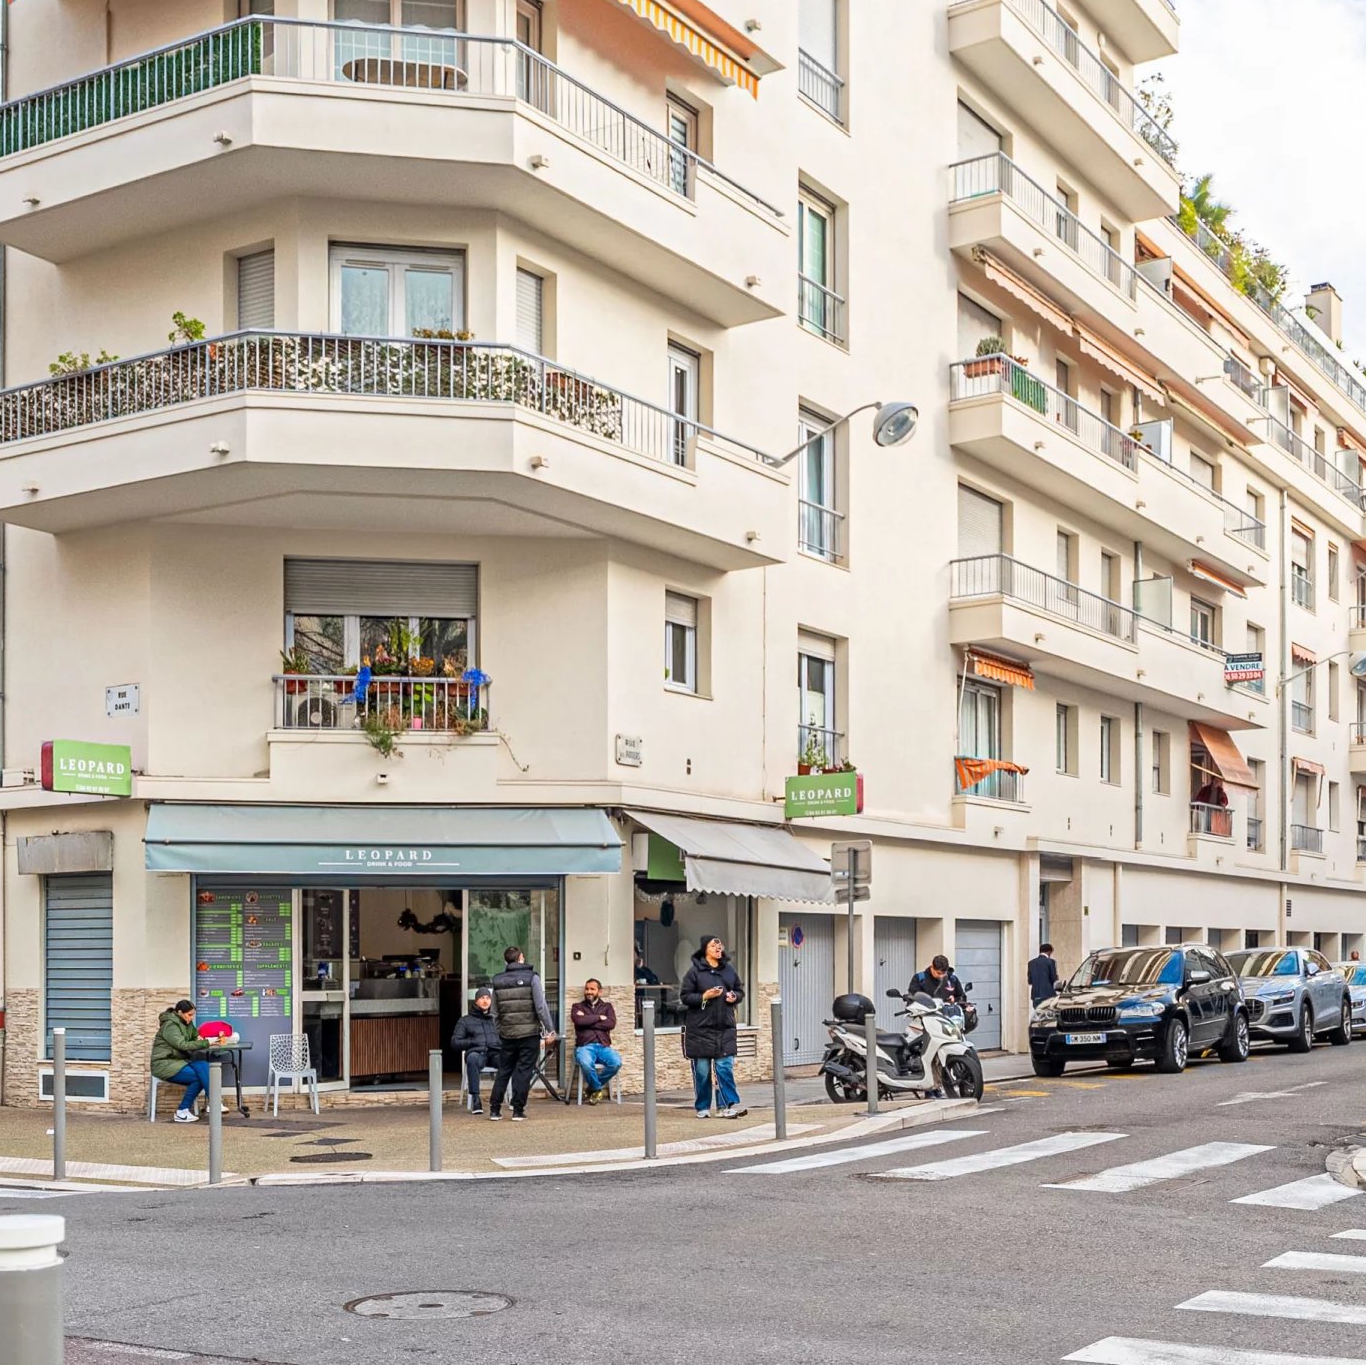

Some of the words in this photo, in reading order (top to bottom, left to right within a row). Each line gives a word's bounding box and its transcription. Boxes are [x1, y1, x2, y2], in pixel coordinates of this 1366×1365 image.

[1230, 662, 1260, 671] VENDRE
[118, 691, 127, 699] RUE
[115, 702, 131, 711] DANTE
[60, 757, 125, 774] LEOPARD
[791, 787, 852, 801] LEOPARD
[345, 850, 433, 860] LEOPARD
